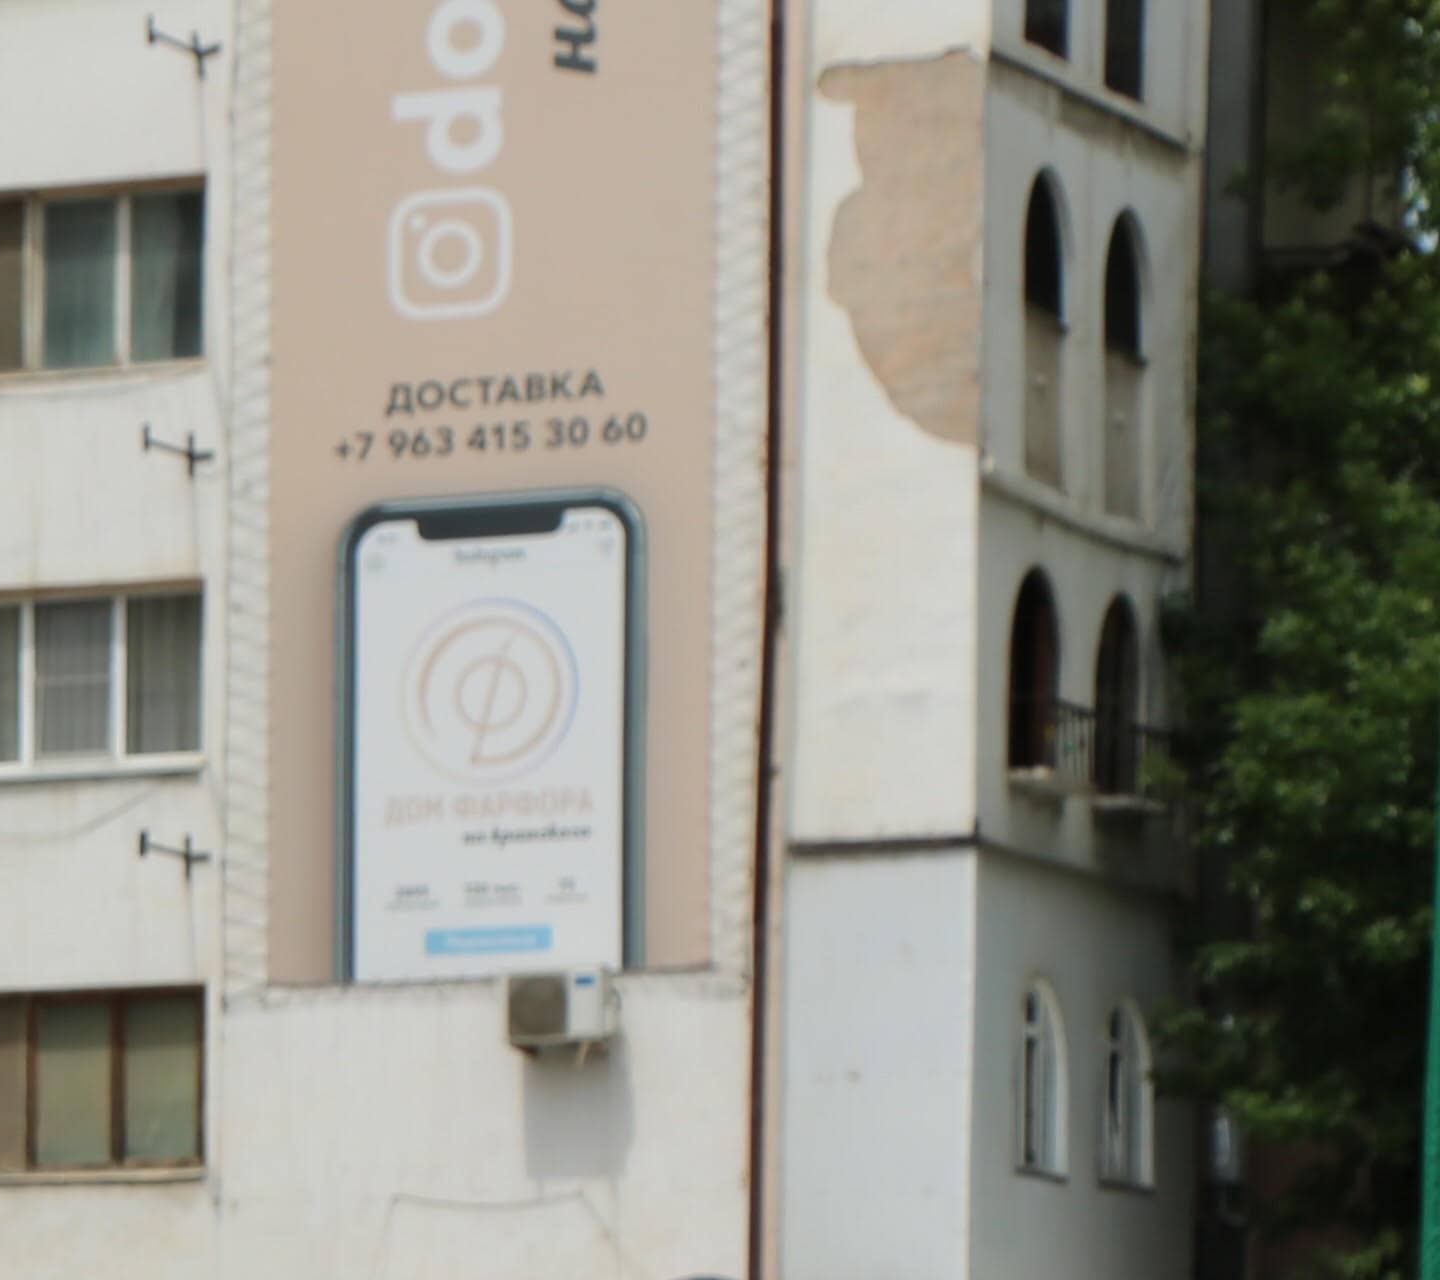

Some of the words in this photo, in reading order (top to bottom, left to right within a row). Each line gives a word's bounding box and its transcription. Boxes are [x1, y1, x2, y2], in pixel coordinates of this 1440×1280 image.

[384, 369, 606, 417] ДОСТАВКА
[333, 432, 374, 461] +7
[387, 426, 455, 459] 963
[467, 420, 531, 453] 415
[544, 416, 590, 449] 30
[601, 411, 648, 445] 60
